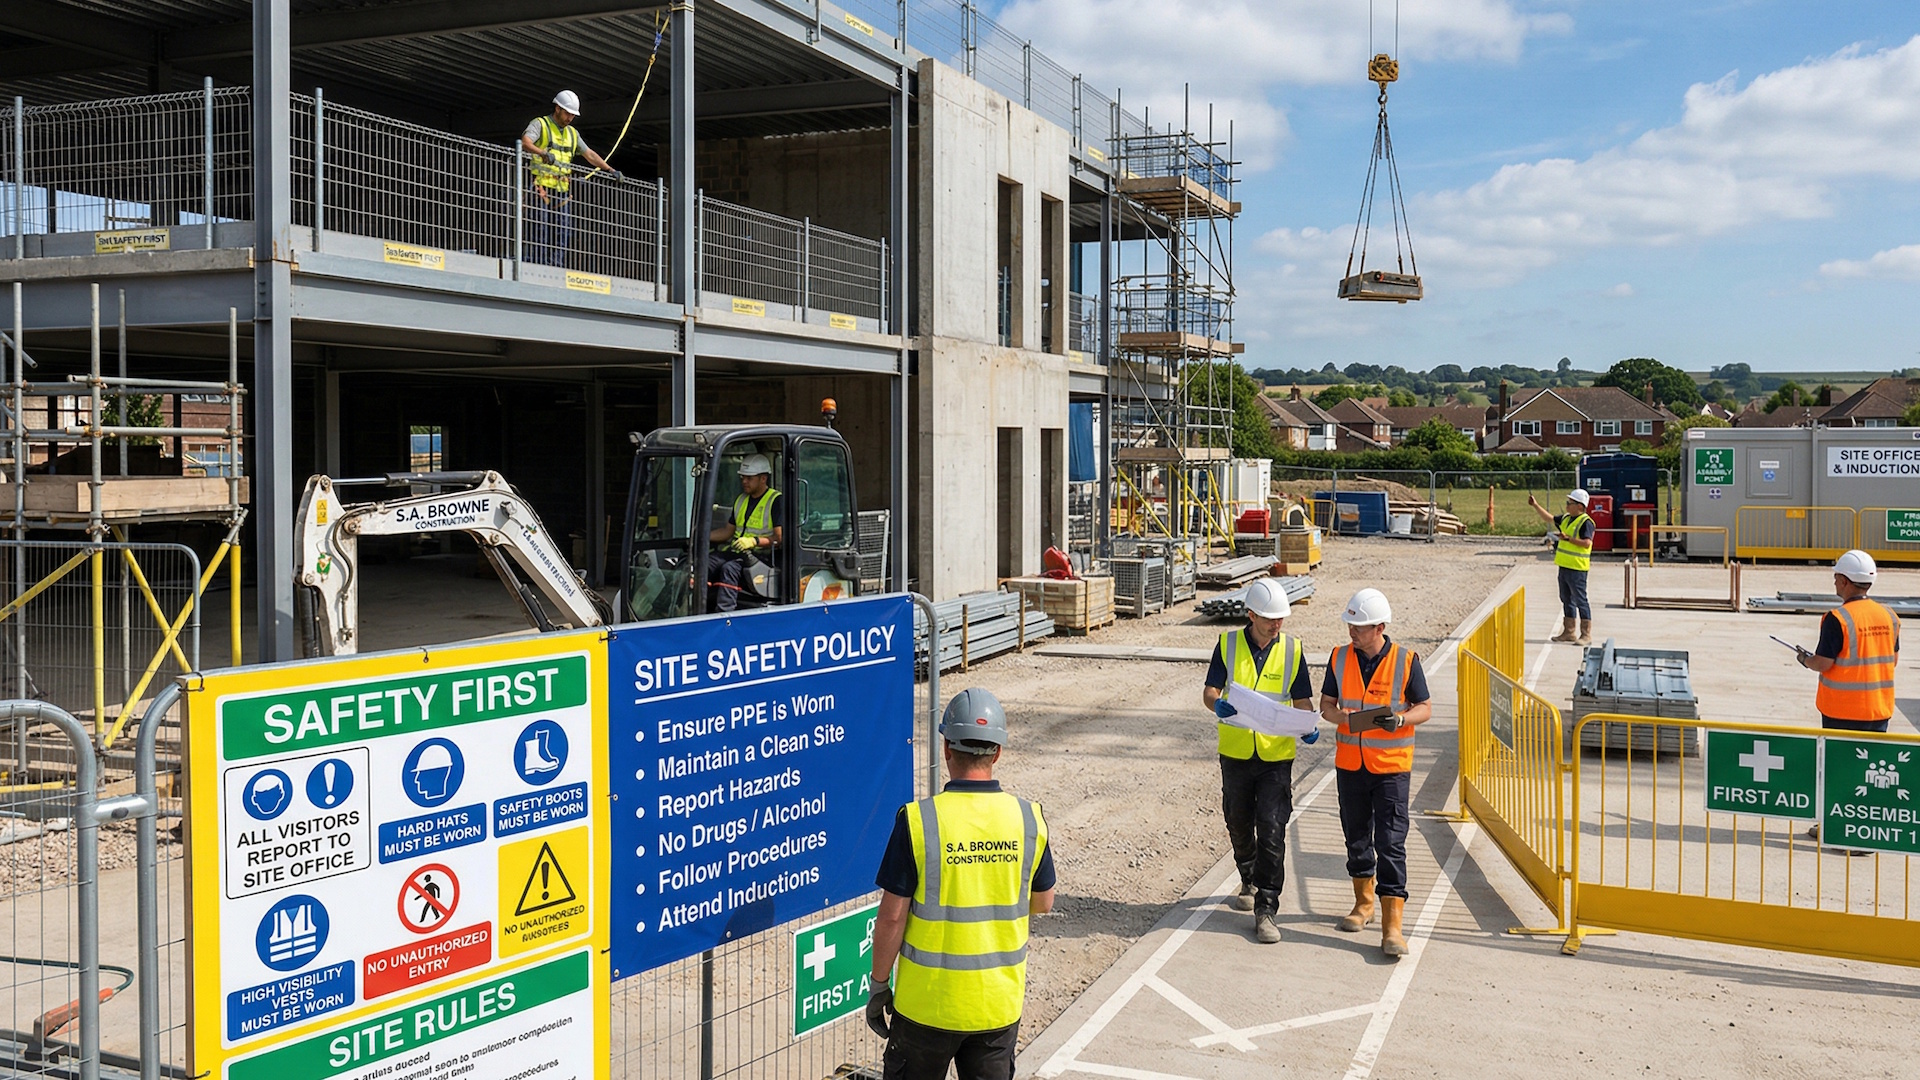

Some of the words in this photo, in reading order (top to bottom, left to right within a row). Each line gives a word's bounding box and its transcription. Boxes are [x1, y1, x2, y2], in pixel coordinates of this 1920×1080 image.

[1833, 464, 1842, 474] &
[1847, 464, 1920, 474] INDUCTION
[1840, 450, 1869, 460] SITE
[1873, 450, 1920, 461] OFFICE
[396, 507, 424, 522] S.A.
[428, 499, 489, 518] BROWNE
[635, 653, 699, 691] SITE
[708, 638, 806, 680] SAFETY
[814, 624, 895, 663] POLICY
[264, 684, 438, 743] SAFETY
[452, 668, 559, 716] FIRST
[658, 715, 725, 743] Ensure
[731, 702, 767, 729] PPE
[773, 700, 787, 721] is
[791, 694, 834, 716] Worn
[658, 745, 739, 781] Maintain
[745, 745, 755, 762] a
[761, 734, 809, 758] Clean
[814, 724, 844, 746] Site
[500, 796, 543, 815] SAFETY
[546, 788, 583, 805] BOOTS
[659, 784, 724, 818] Report
[730, 767, 801, 801] Hazards
[1714, 786, 1770, 805] FIRST
[1775, 792, 1809, 808] AID
[237, 829, 273, 848] ALL
[278, 811, 359, 839] VISITORS
[398, 820, 434, 838] HARD
[437, 813, 468, 829] HATS
[499, 813, 530, 831] MUST
[533, 809, 548, 823] BE
[550, 802, 583, 818] WORN
[659, 832, 686, 856] No
[692, 818, 747, 848] Drugs
[751, 809, 758, 832] /
[762, 792, 825, 829] Alcohol
[1830, 803, 1920, 824] ASSEMBL
[248, 837, 322, 867] REPORT
[327, 832, 351, 849] TO
[385, 838, 421, 856] MUST
[425, 834, 441, 847] BE
[443, 824, 481, 843] WORN
[946, 842, 968, 853] S.A.
[970, 841, 1018, 852] BROWNE
[1845, 824, 1903, 842] POINT
[1909, 830, 1916, 844] 1
[244, 866, 285, 888] SITE
[290, 851, 354, 877] OFFICE
[659, 861, 722, 894] Follow
[728, 831, 827, 875] Procedures
[946, 854, 1018, 865] CONSTRUCTION
[658, 891, 722, 932] Attend
[728, 866, 819, 910] Inductions
[504, 924, 518, 936] NO
[368, 959, 387, 975] NO
[391, 930, 488, 968] UNAUTHORIZED
[409, 956, 450, 978] ENTRY
[242, 985, 275, 1005] HIGH
[278, 966, 343, 994] VISIBILITY
[272, 988, 314, 1009] VESTS
[803, 979, 854, 1019] FIRST
[241, 1012, 279, 1033] MUST
[283, 1005, 301, 1021] BE
[304, 993, 343, 1014] WORN
[329, 1018, 404, 1069] SITE
[415, 982, 516, 1040] RULES
